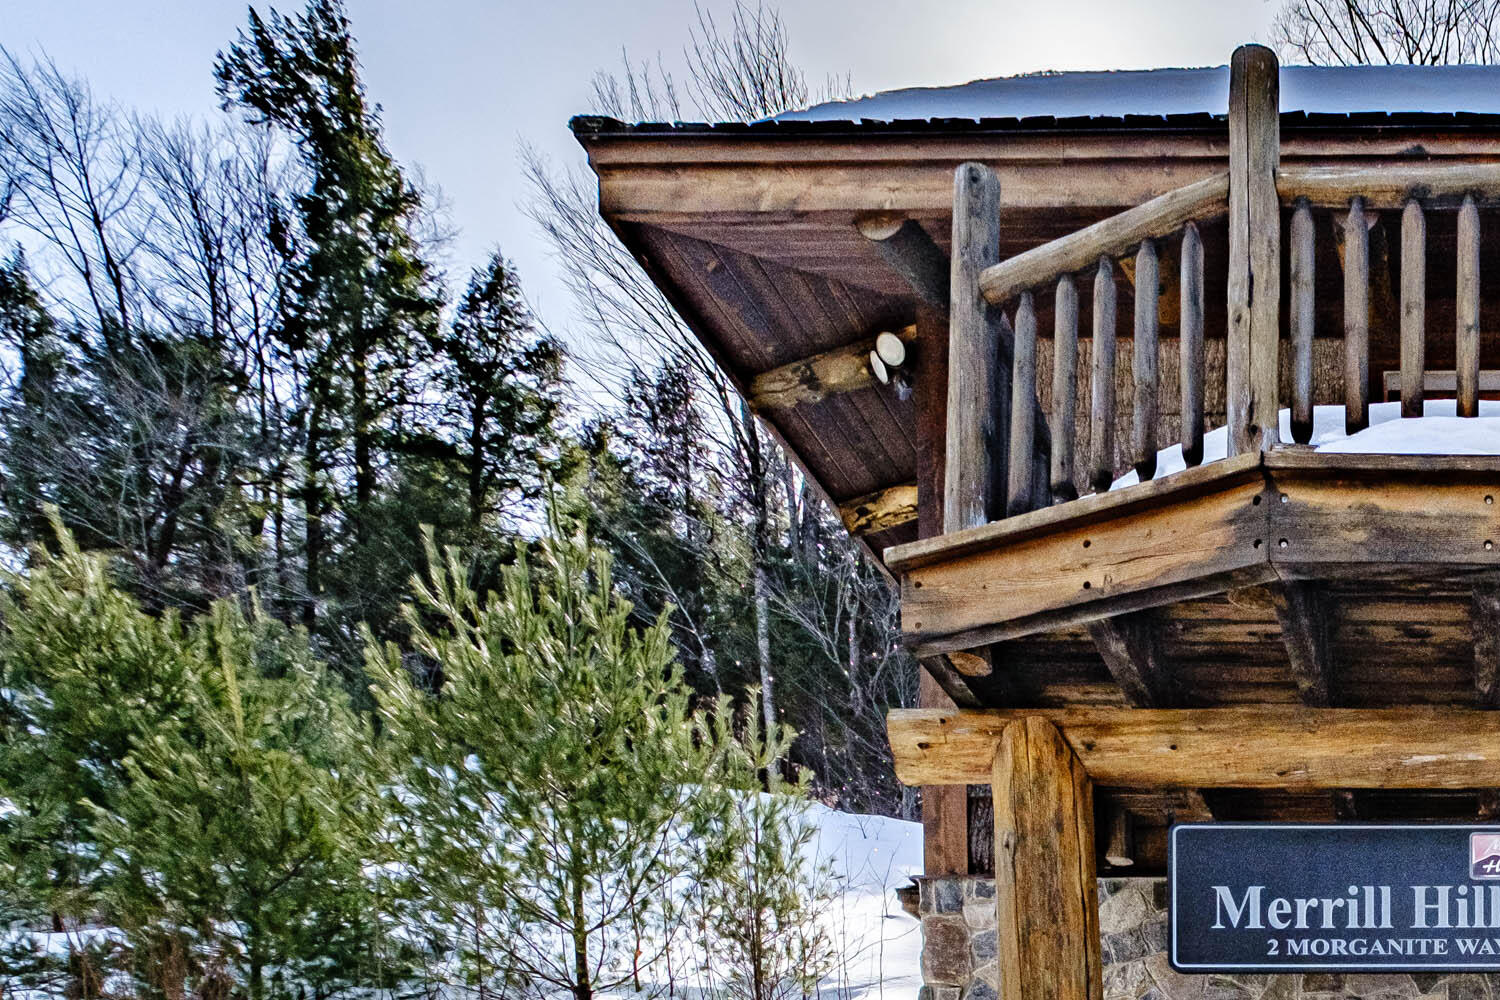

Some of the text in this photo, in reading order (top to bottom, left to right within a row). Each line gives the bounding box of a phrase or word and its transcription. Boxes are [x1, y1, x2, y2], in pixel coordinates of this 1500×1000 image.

[1211, 885, 1394, 930] Merrill
[1267, 938, 1279, 956] 2
[1287, 938, 1449, 956] MORGANITE
